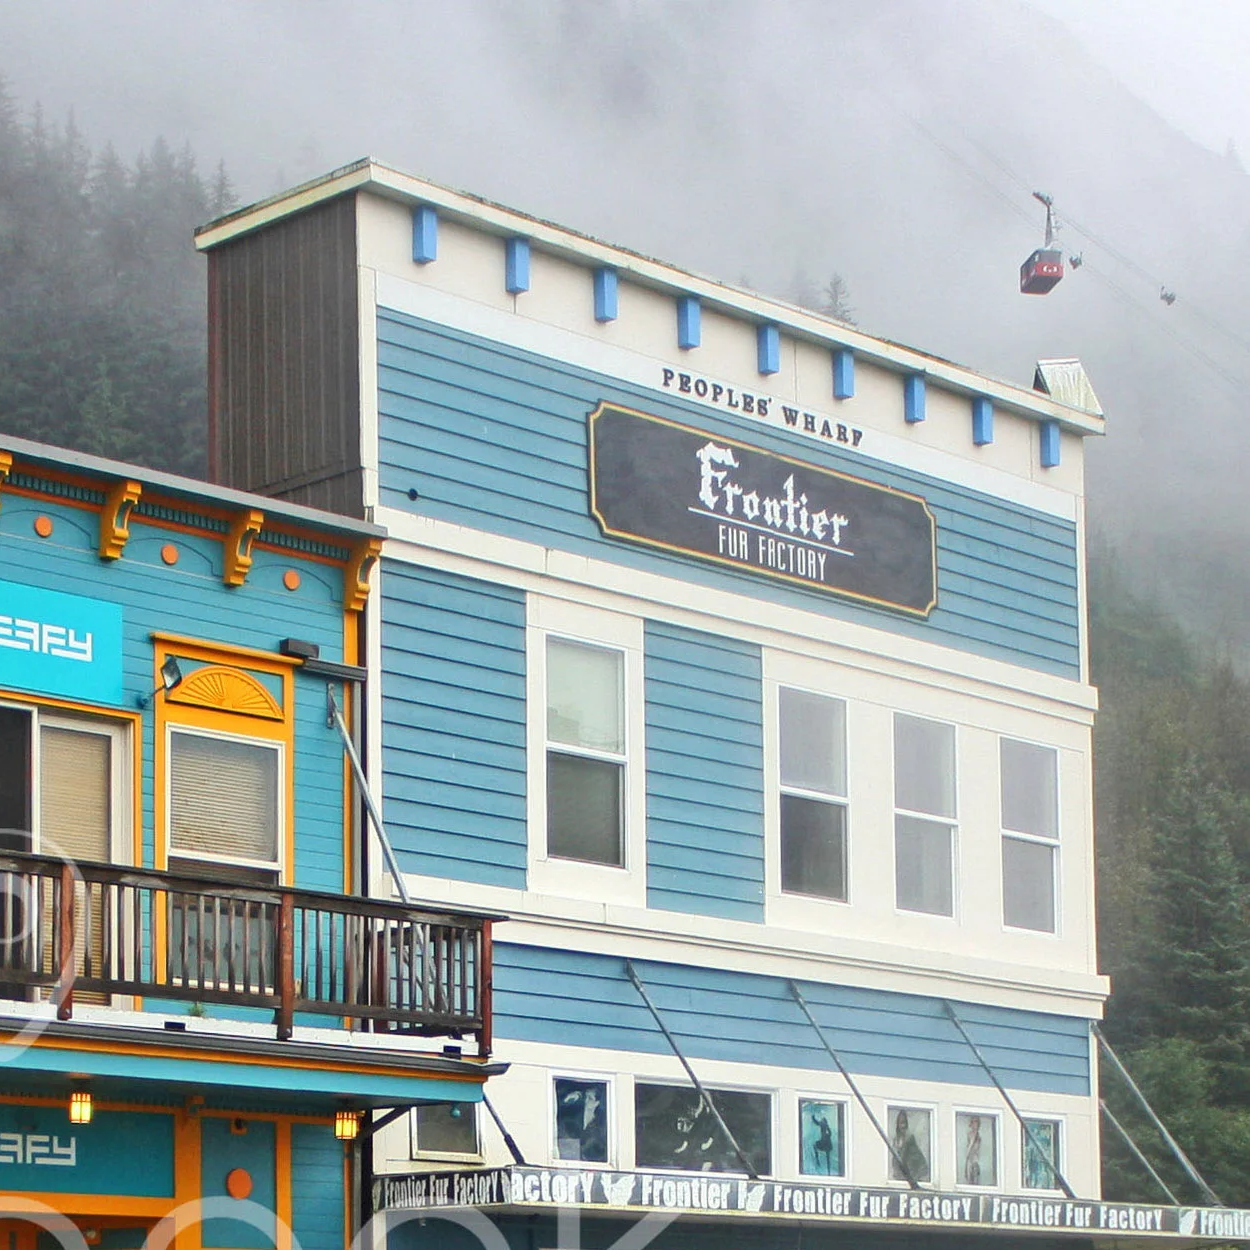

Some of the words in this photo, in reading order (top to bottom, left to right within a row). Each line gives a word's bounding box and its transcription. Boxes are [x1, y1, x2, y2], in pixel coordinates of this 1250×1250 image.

[662, 368, 772, 416] PEOPLES'
[782, 406, 863, 447] WHARF
[696, 442, 848, 545] Frontier
[718, 525, 748, 560] FUR
[757, 535, 827, 581] FACTORY
[384, 1176, 426, 1208] Frontier
[429, 1174, 450, 1205] Fur
[641, 1175, 731, 1209] Frontier
[773, 1184, 852, 1215] Frontier
[859, 1191, 890, 1218] Fur
[992, 1197, 1062, 1227] Frontier
[1065, 1203, 1093, 1228] Fur
